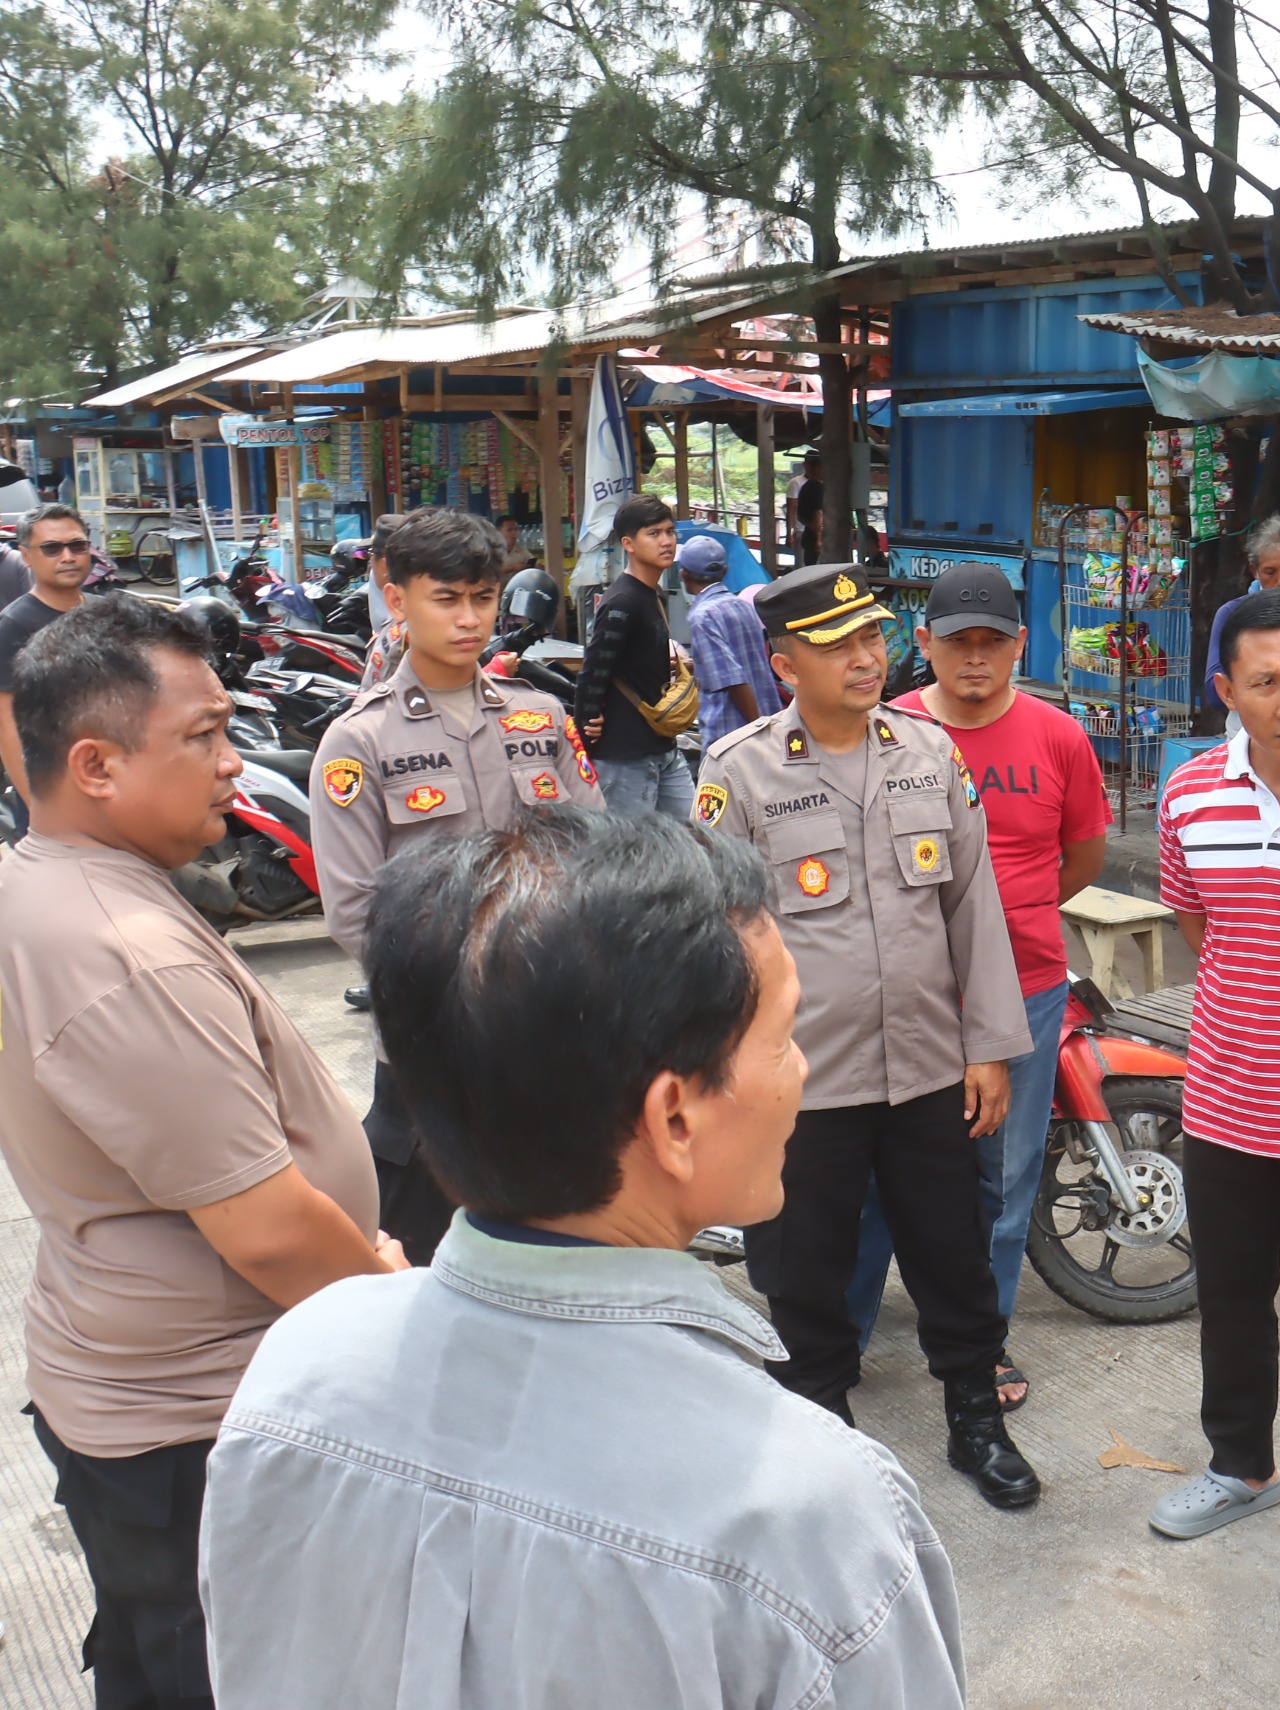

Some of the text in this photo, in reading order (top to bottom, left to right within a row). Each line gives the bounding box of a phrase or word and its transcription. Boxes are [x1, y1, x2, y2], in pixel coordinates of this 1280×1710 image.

[238, 426, 330, 443] PENTOL TOP
[381, 752, 453, 778] I.SENA
[886, 774, 939, 793] POLISI
[969, 764, 1039, 795] ALI
[764, 792, 830, 818] SUHARTA
